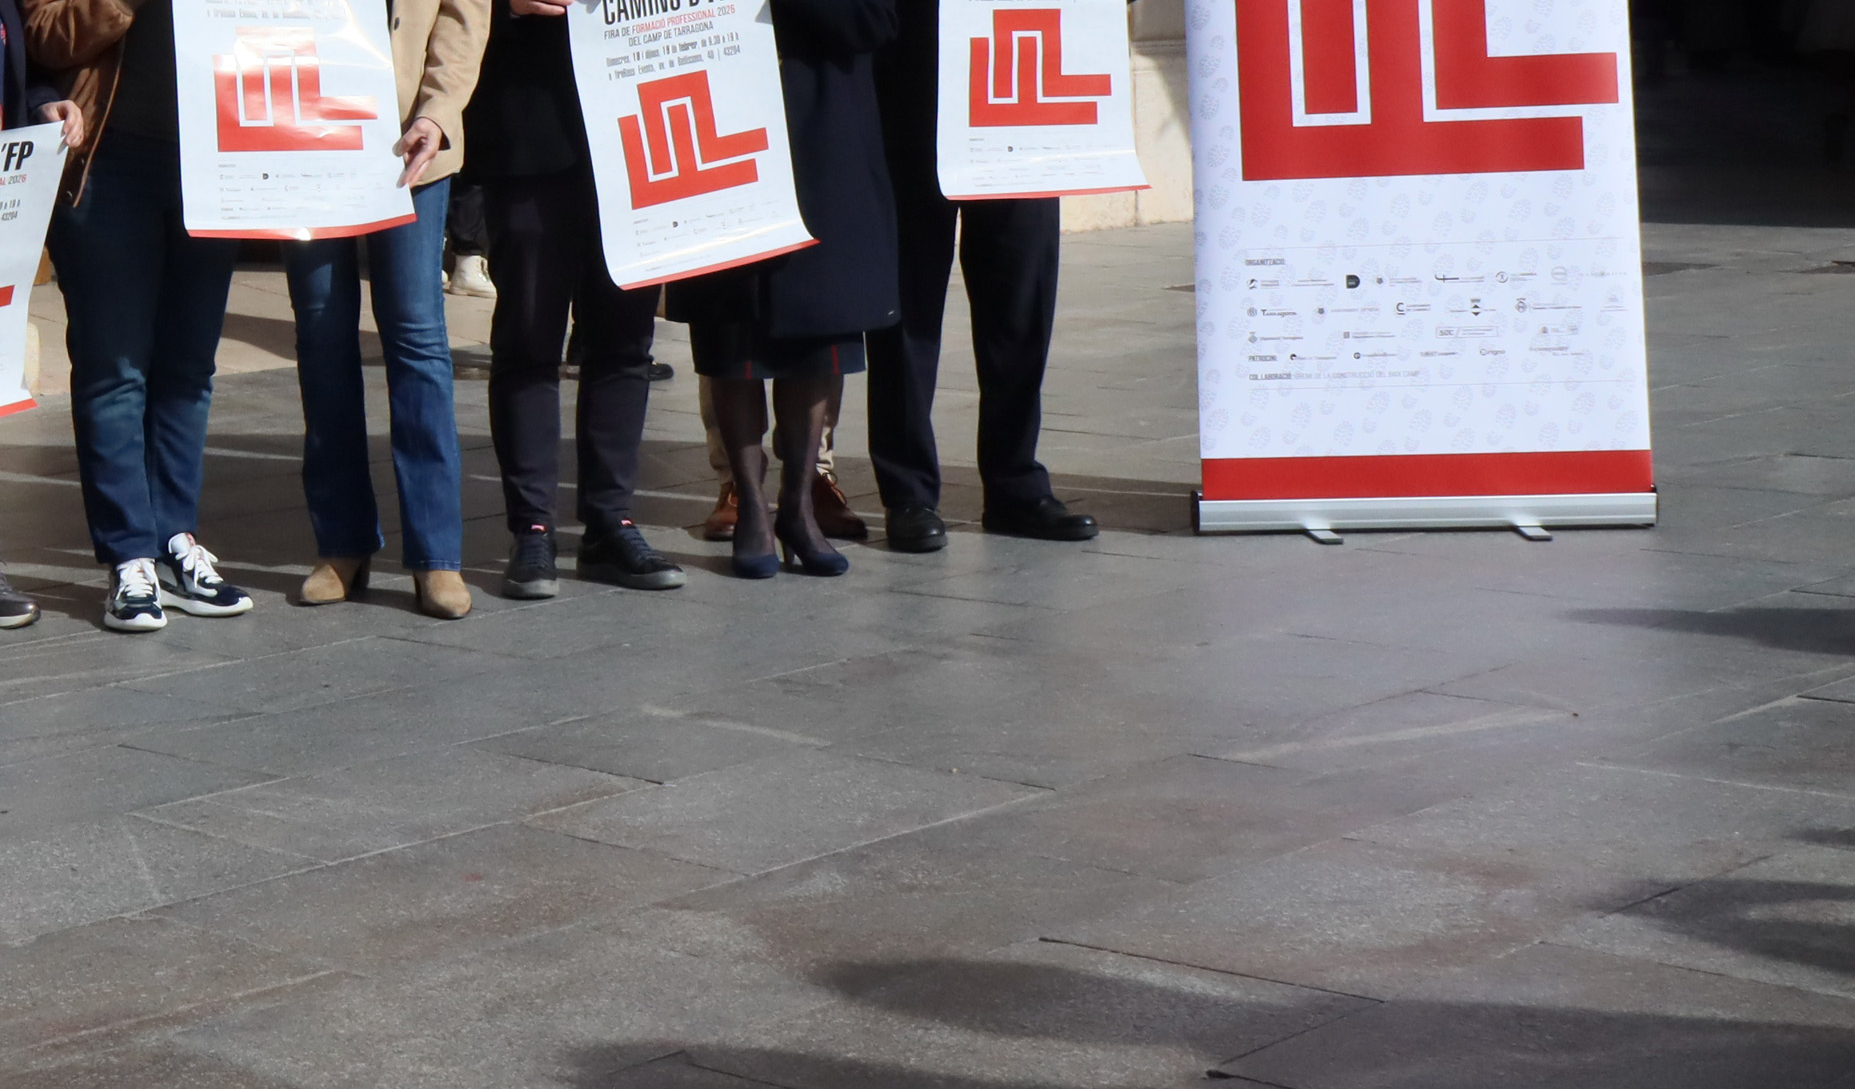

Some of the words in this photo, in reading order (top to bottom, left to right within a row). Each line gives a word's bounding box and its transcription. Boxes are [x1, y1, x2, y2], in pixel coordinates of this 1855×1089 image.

[604, 28, 620, 40] FIRA
[622, 27, 631, 36] DE
[667, 9, 715, 26] PROFESSIONAL
[717, 4, 735, 16] 2026
[629, 37, 641, 46] DEL
[644, 32, 662, 44] CAMP
[664, 30, 672, 39] DE
[674, 21, 713, 36] TARRAGONA
